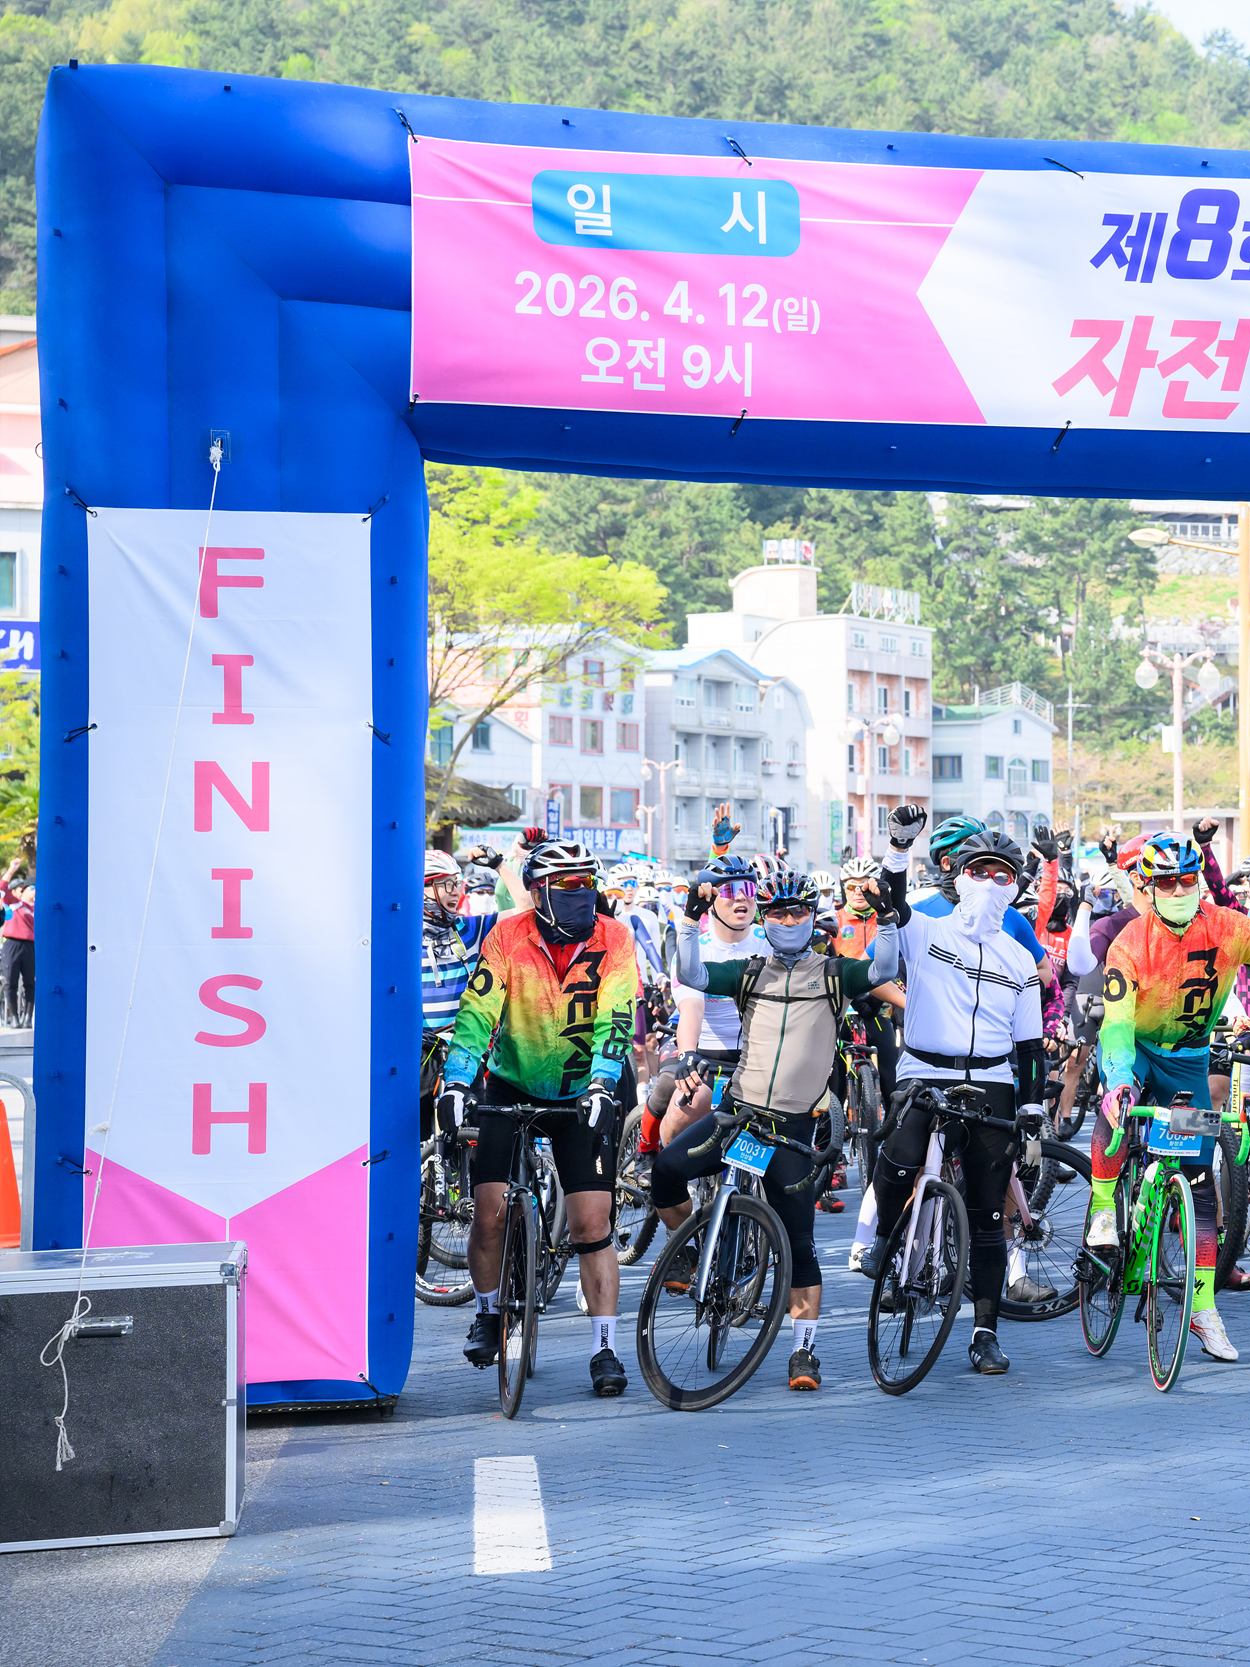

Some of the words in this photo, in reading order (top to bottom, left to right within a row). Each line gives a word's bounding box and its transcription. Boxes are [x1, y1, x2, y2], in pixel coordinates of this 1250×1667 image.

[566, 183, 613, 237] 일
[719, 190, 769, 245] 시
[513, 270, 650, 322] 2026.
[662, 279, 705, 325] 4.
[717, 282, 822, 335] 12(일)
[580, 336, 666, 393] 오전
[681, 341, 754, 397] 9시
[192, 546, 270, 1156] FINISH
[733, 1137, 767, 1159] 70031
[435, 1171, 446, 1196] FOX
